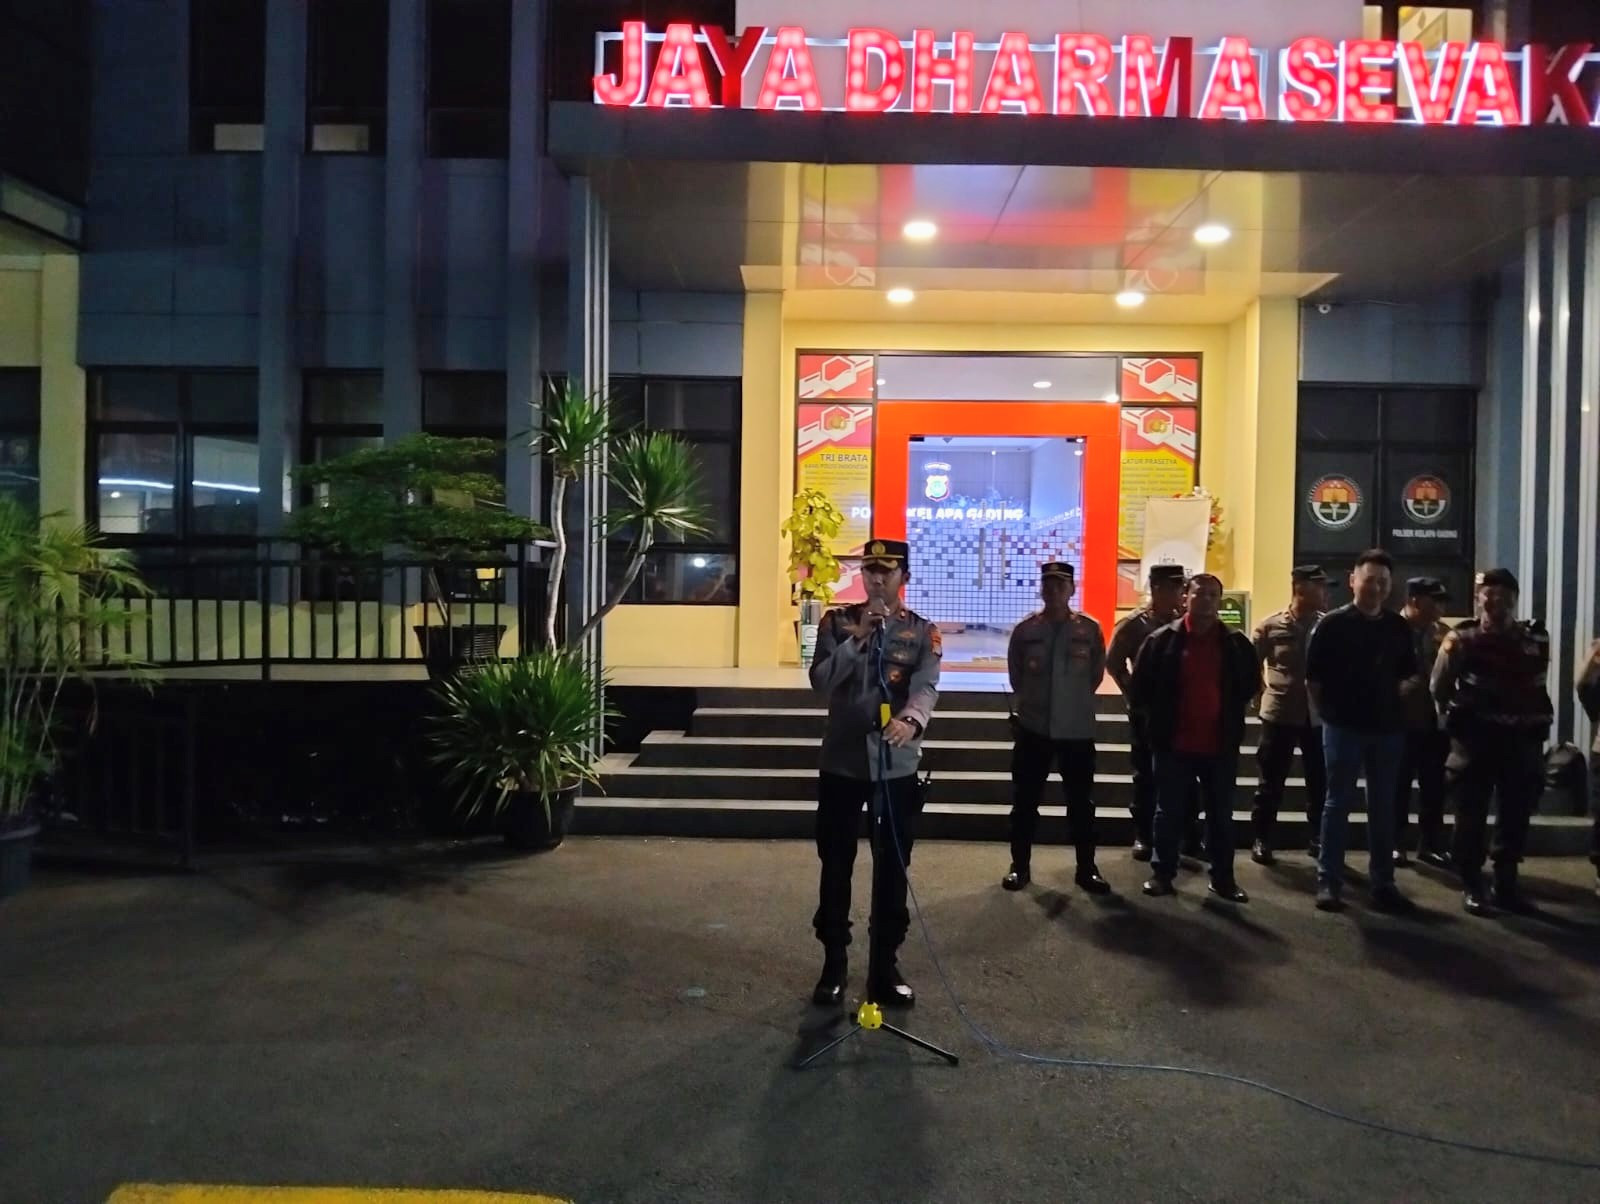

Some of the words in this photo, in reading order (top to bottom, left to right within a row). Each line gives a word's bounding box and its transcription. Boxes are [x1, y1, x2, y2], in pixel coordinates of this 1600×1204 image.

[593, 20, 822, 111] JAYA
[845, 28, 1266, 120] DHARMA
[1281, 37, 1600, 127] SEVAK
[820, 453, 834, 462] TRI
[838, 453, 868, 462] BRATA
